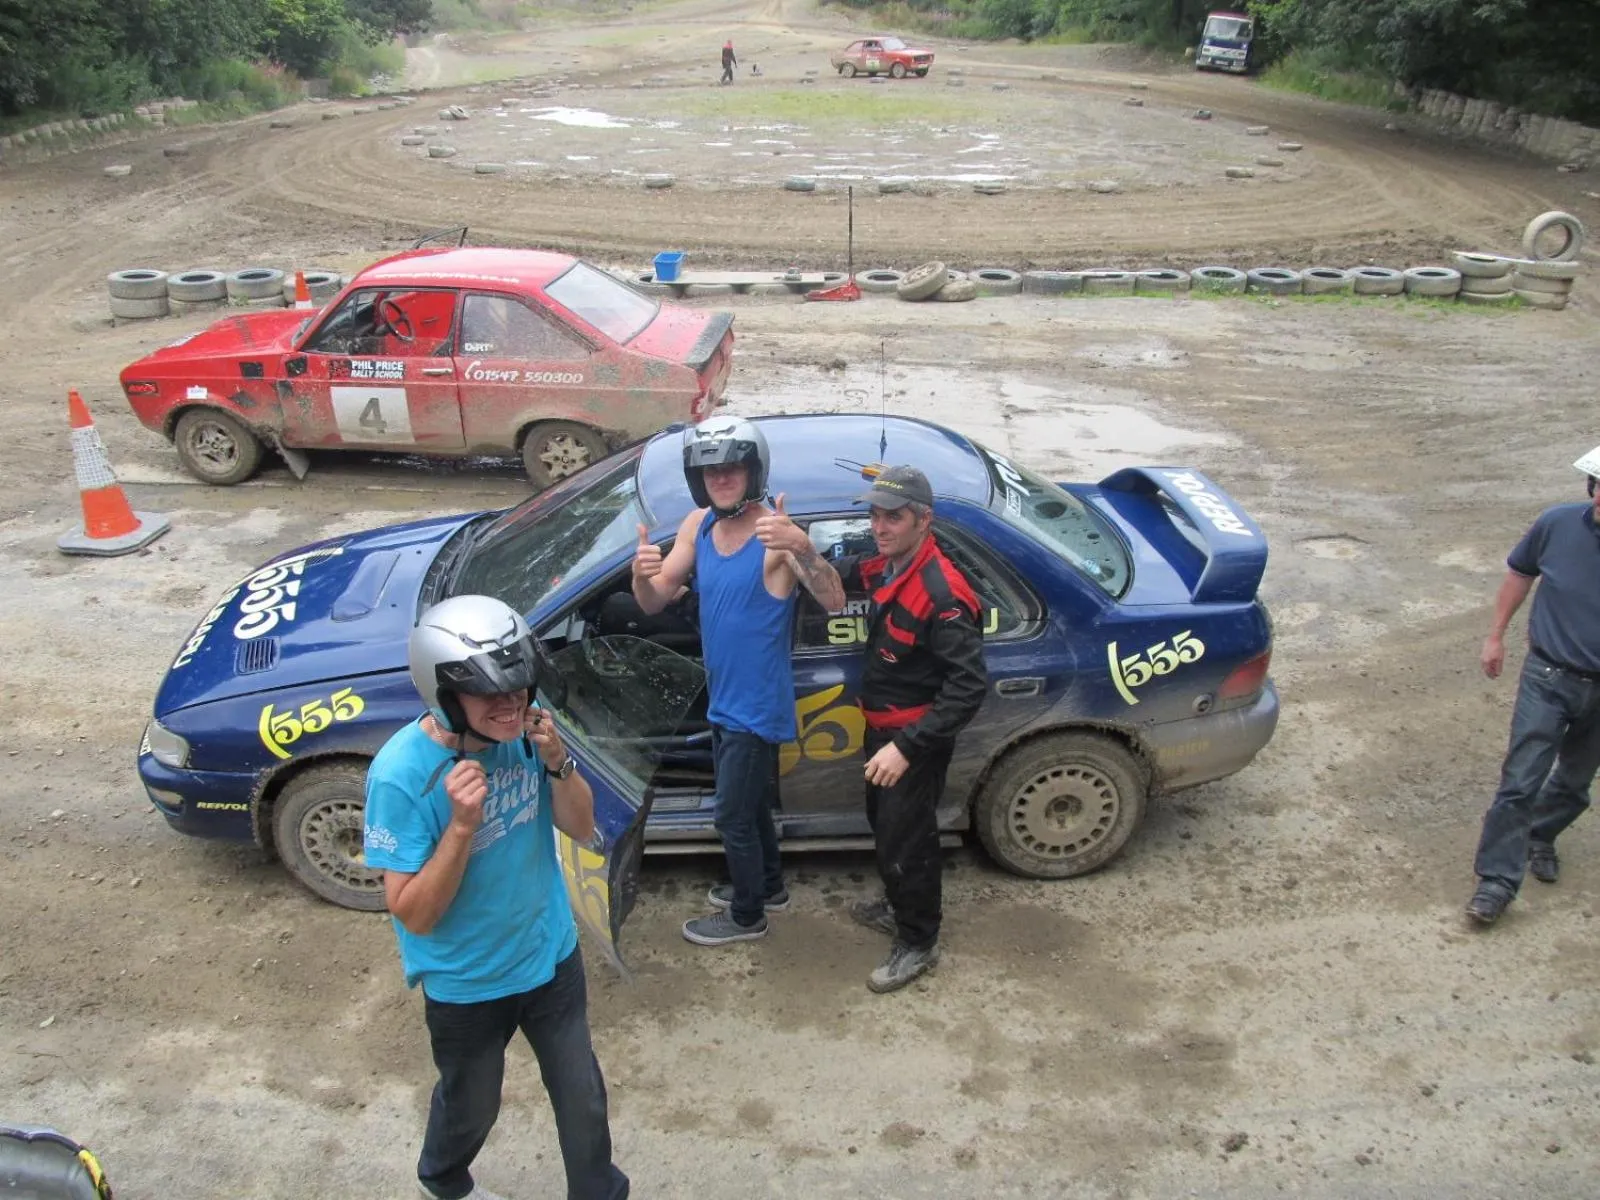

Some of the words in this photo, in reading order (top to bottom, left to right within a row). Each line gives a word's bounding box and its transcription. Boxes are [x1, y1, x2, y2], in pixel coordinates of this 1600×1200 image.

[350, 369, 374, 378] RALLY
[374, 370, 404, 380] SCHOOL
[351, 360, 374, 370] PHIL
[375, 360, 404, 371] PRICE
[473, 370, 519, 382] 01547
[359, 397, 388, 435] 4
[233, 559, 306, 640] 555
[1119, 629, 1206, 687] 555
[271, 687, 365, 745] 555
[196, 801, 250, 811] REPSOL
